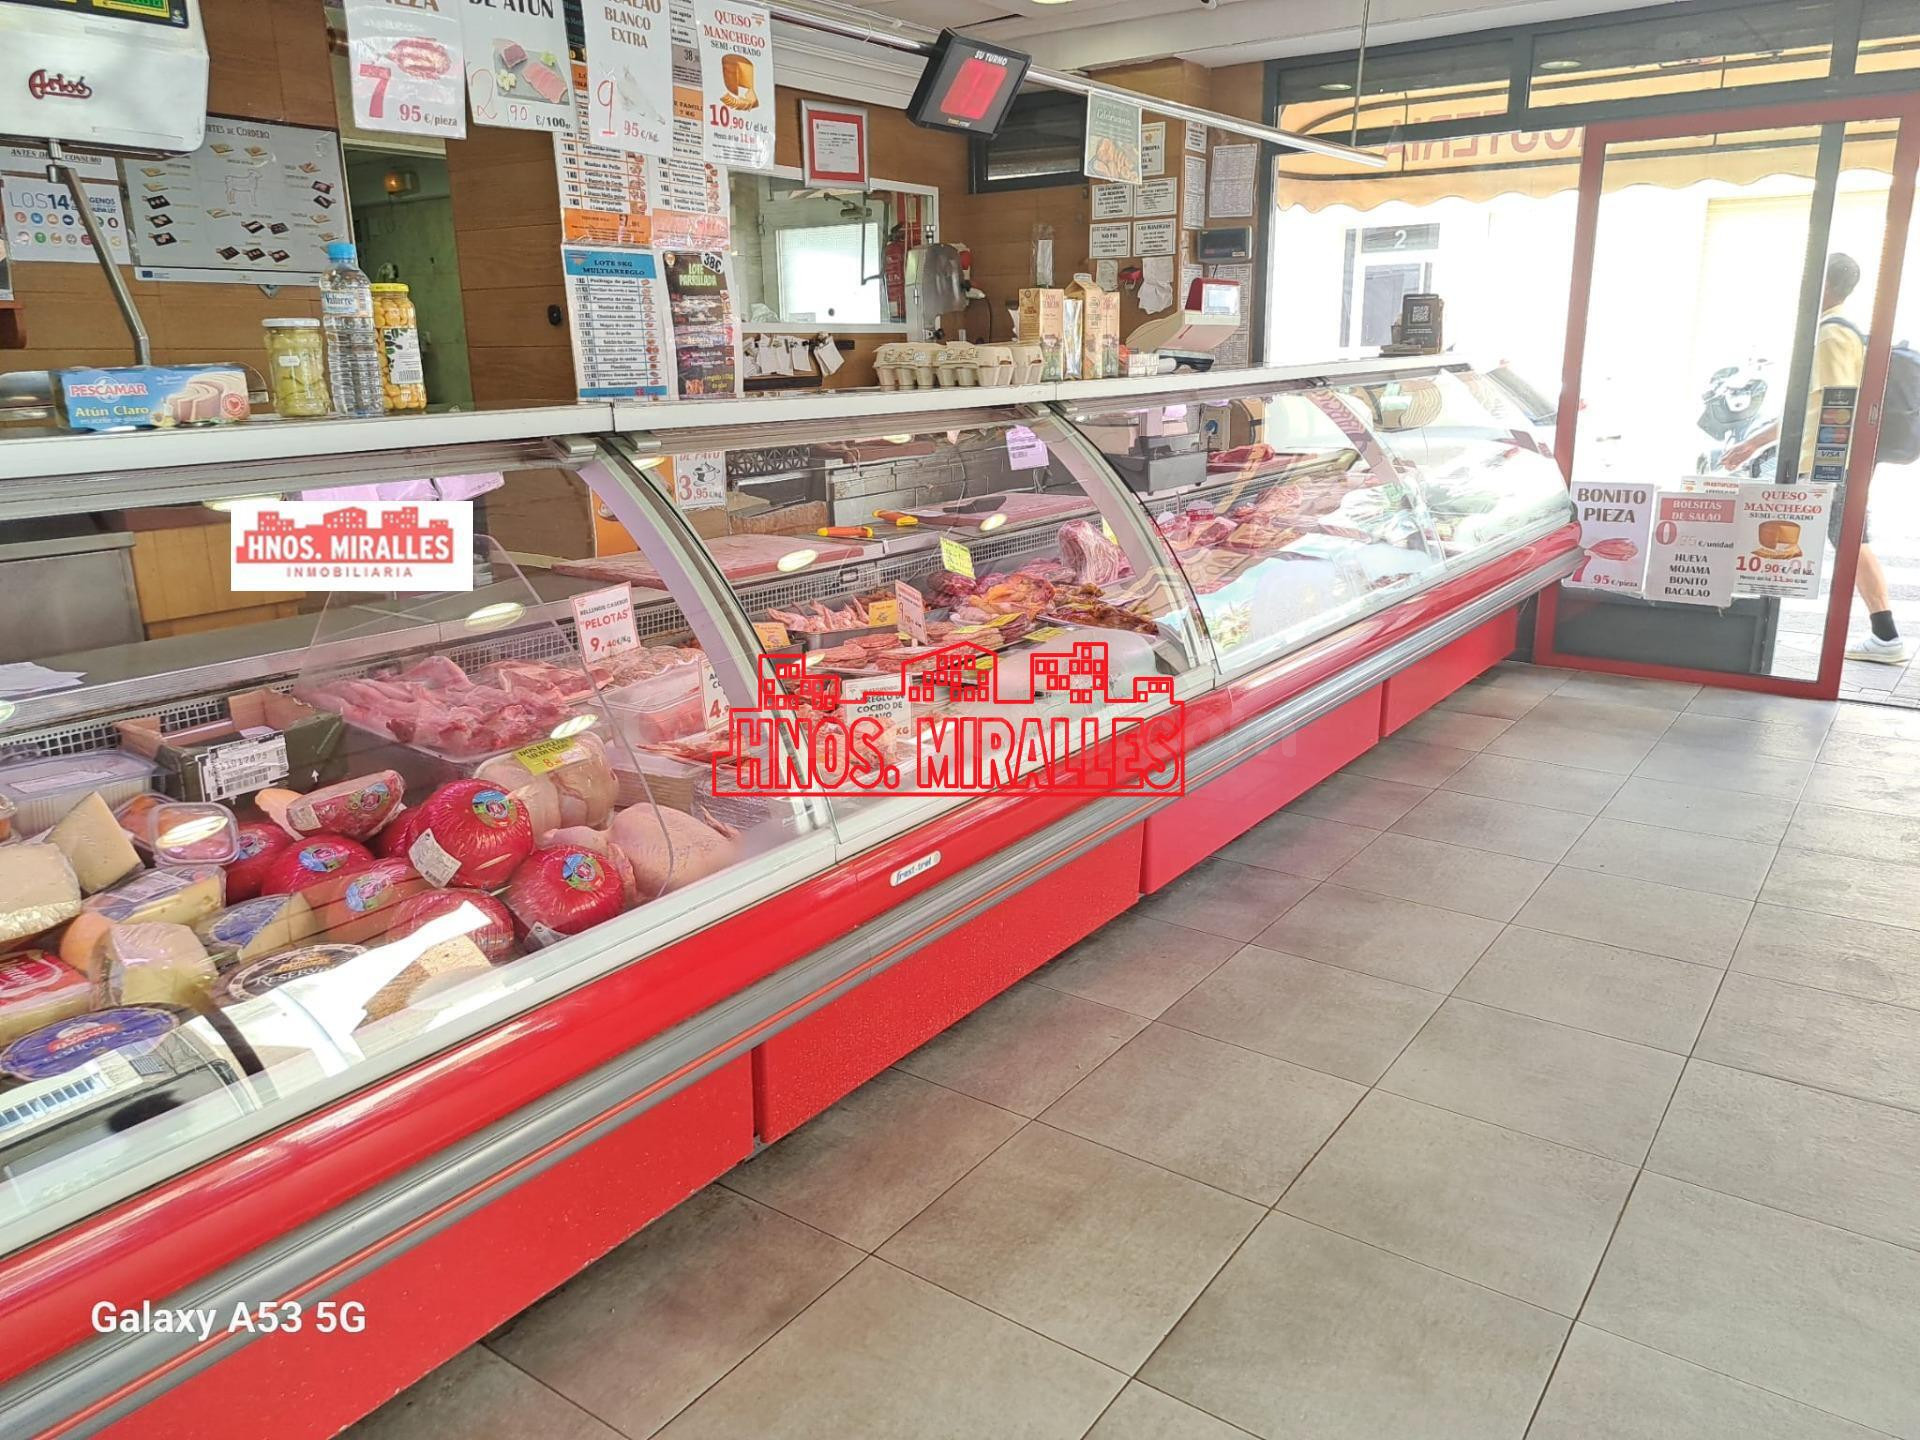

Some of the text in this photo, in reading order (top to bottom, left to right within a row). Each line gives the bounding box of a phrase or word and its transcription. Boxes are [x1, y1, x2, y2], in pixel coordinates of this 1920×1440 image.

[604, 7, 651, 30] BLANCO
[714, 9, 751, 28] QUESO
[611, 27, 649, 48] EXTRA
[704, 25, 766, 49] MANCHEGO
[710, 41, 730, 51] SEMI
[974, 50, 1008, 66] SU TURNO
[358, 63, 392, 118] 7
[399, 103, 422, 122] 95
[10, 192, 48, 209] LOS
[48, 194, 70, 210] 14
[1394, 229, 1407, 248] 2
[71, 383, 148, 396] PESCAMAR
[76, 405, 149, 417] Atún Claro
[1577, 487, 1647, 505] BONITO
[1762, 490, 1807, 500] QUESO
[1672, 500, 1722, 510] BOLSITAS
[1743, 502, 1822, 514] MANCHEGO
[1583, 507, 1635, 523] PIEZA
[1671, 512, 1687, 520] DE
[1655, 521, 1677, 545] 0
[1675, 553, 1708, 563] HUEVA
[1670, 565, 1710, 575] MOJAMA
[1669, 576, 1708, 586] BONITO
[1664, 587, 1711, 598] BACALAO
[857, 703, 891, 713] COCIDO
